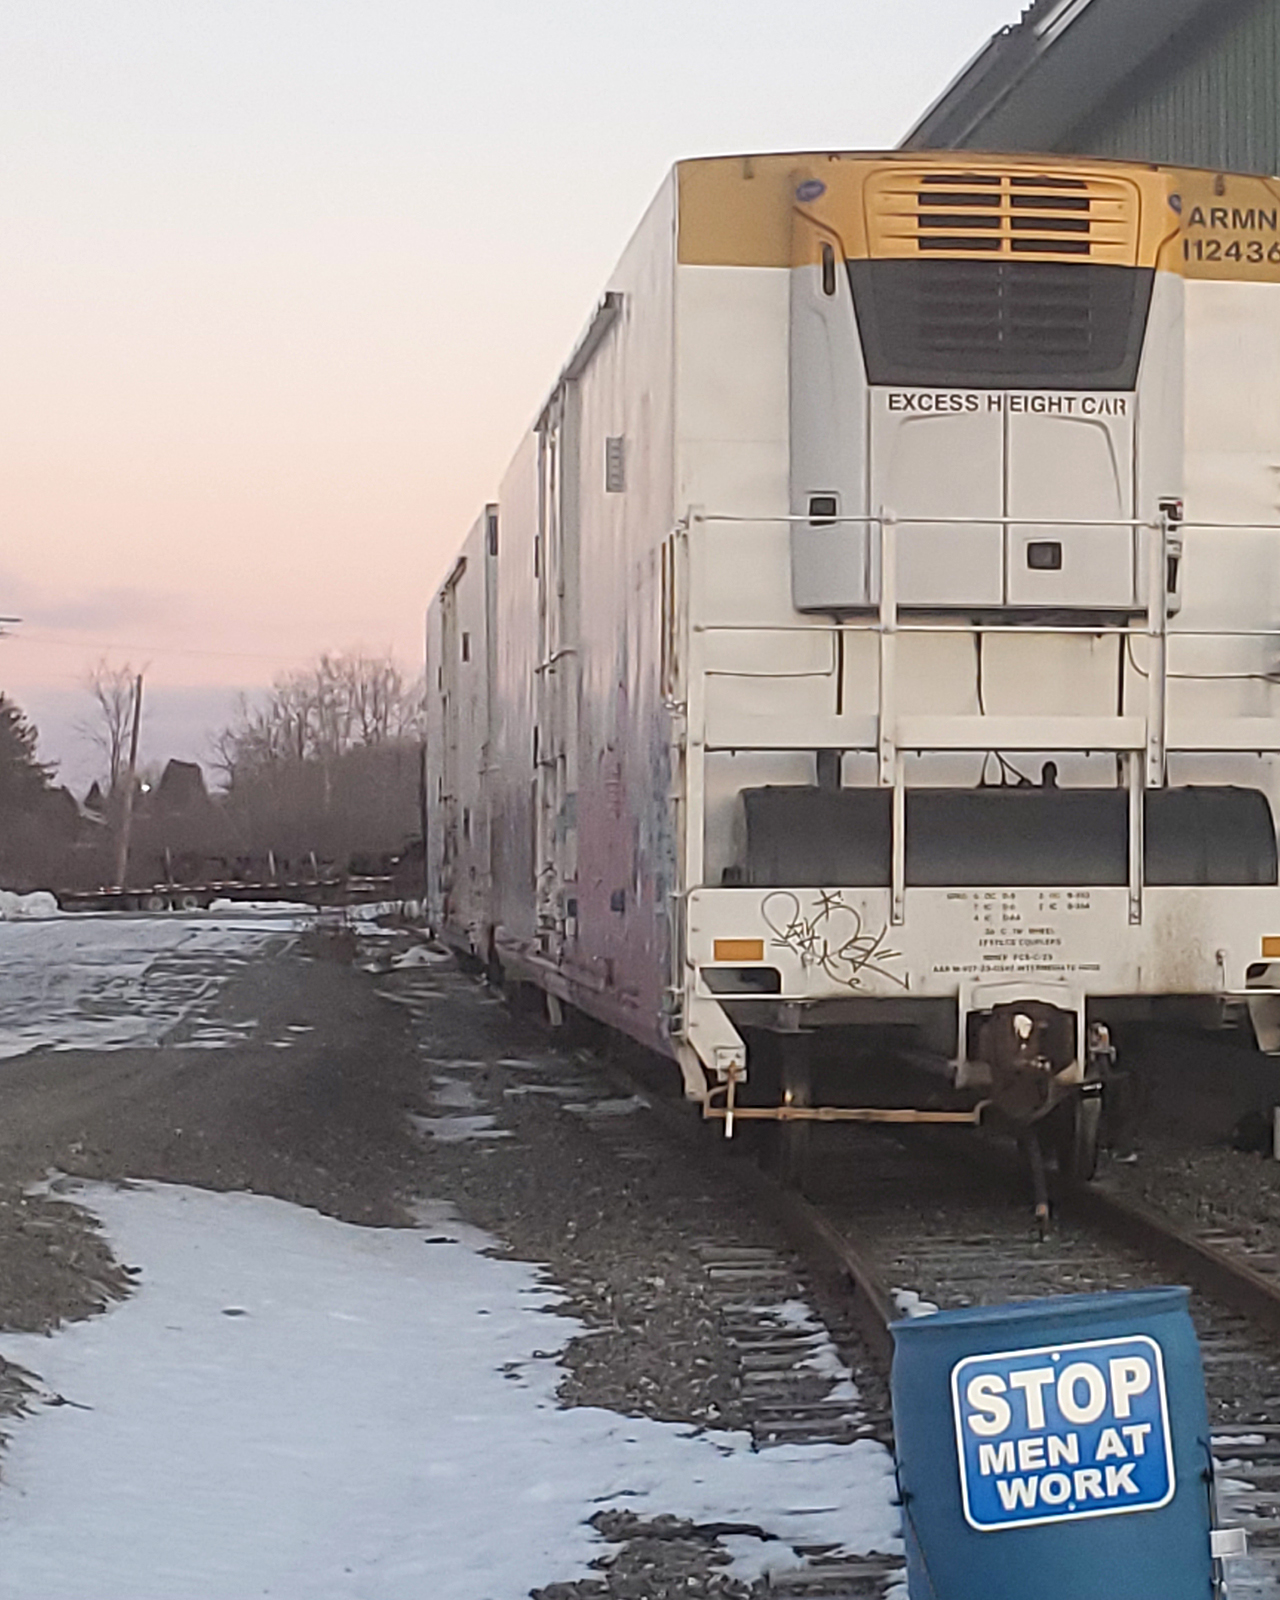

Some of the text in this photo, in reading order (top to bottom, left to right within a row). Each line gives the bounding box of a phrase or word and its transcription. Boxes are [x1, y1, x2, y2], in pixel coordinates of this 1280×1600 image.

[1188, 206, 1277, 231] ARMN
[888, 393, 1126, 416] EXCESS HEIGHT CAR
[967, 1356, 1151, 1436] STOP
[979, 1423, 1151, 1476] MEN AT
[996, 1463, 1140, 1511] WORK
